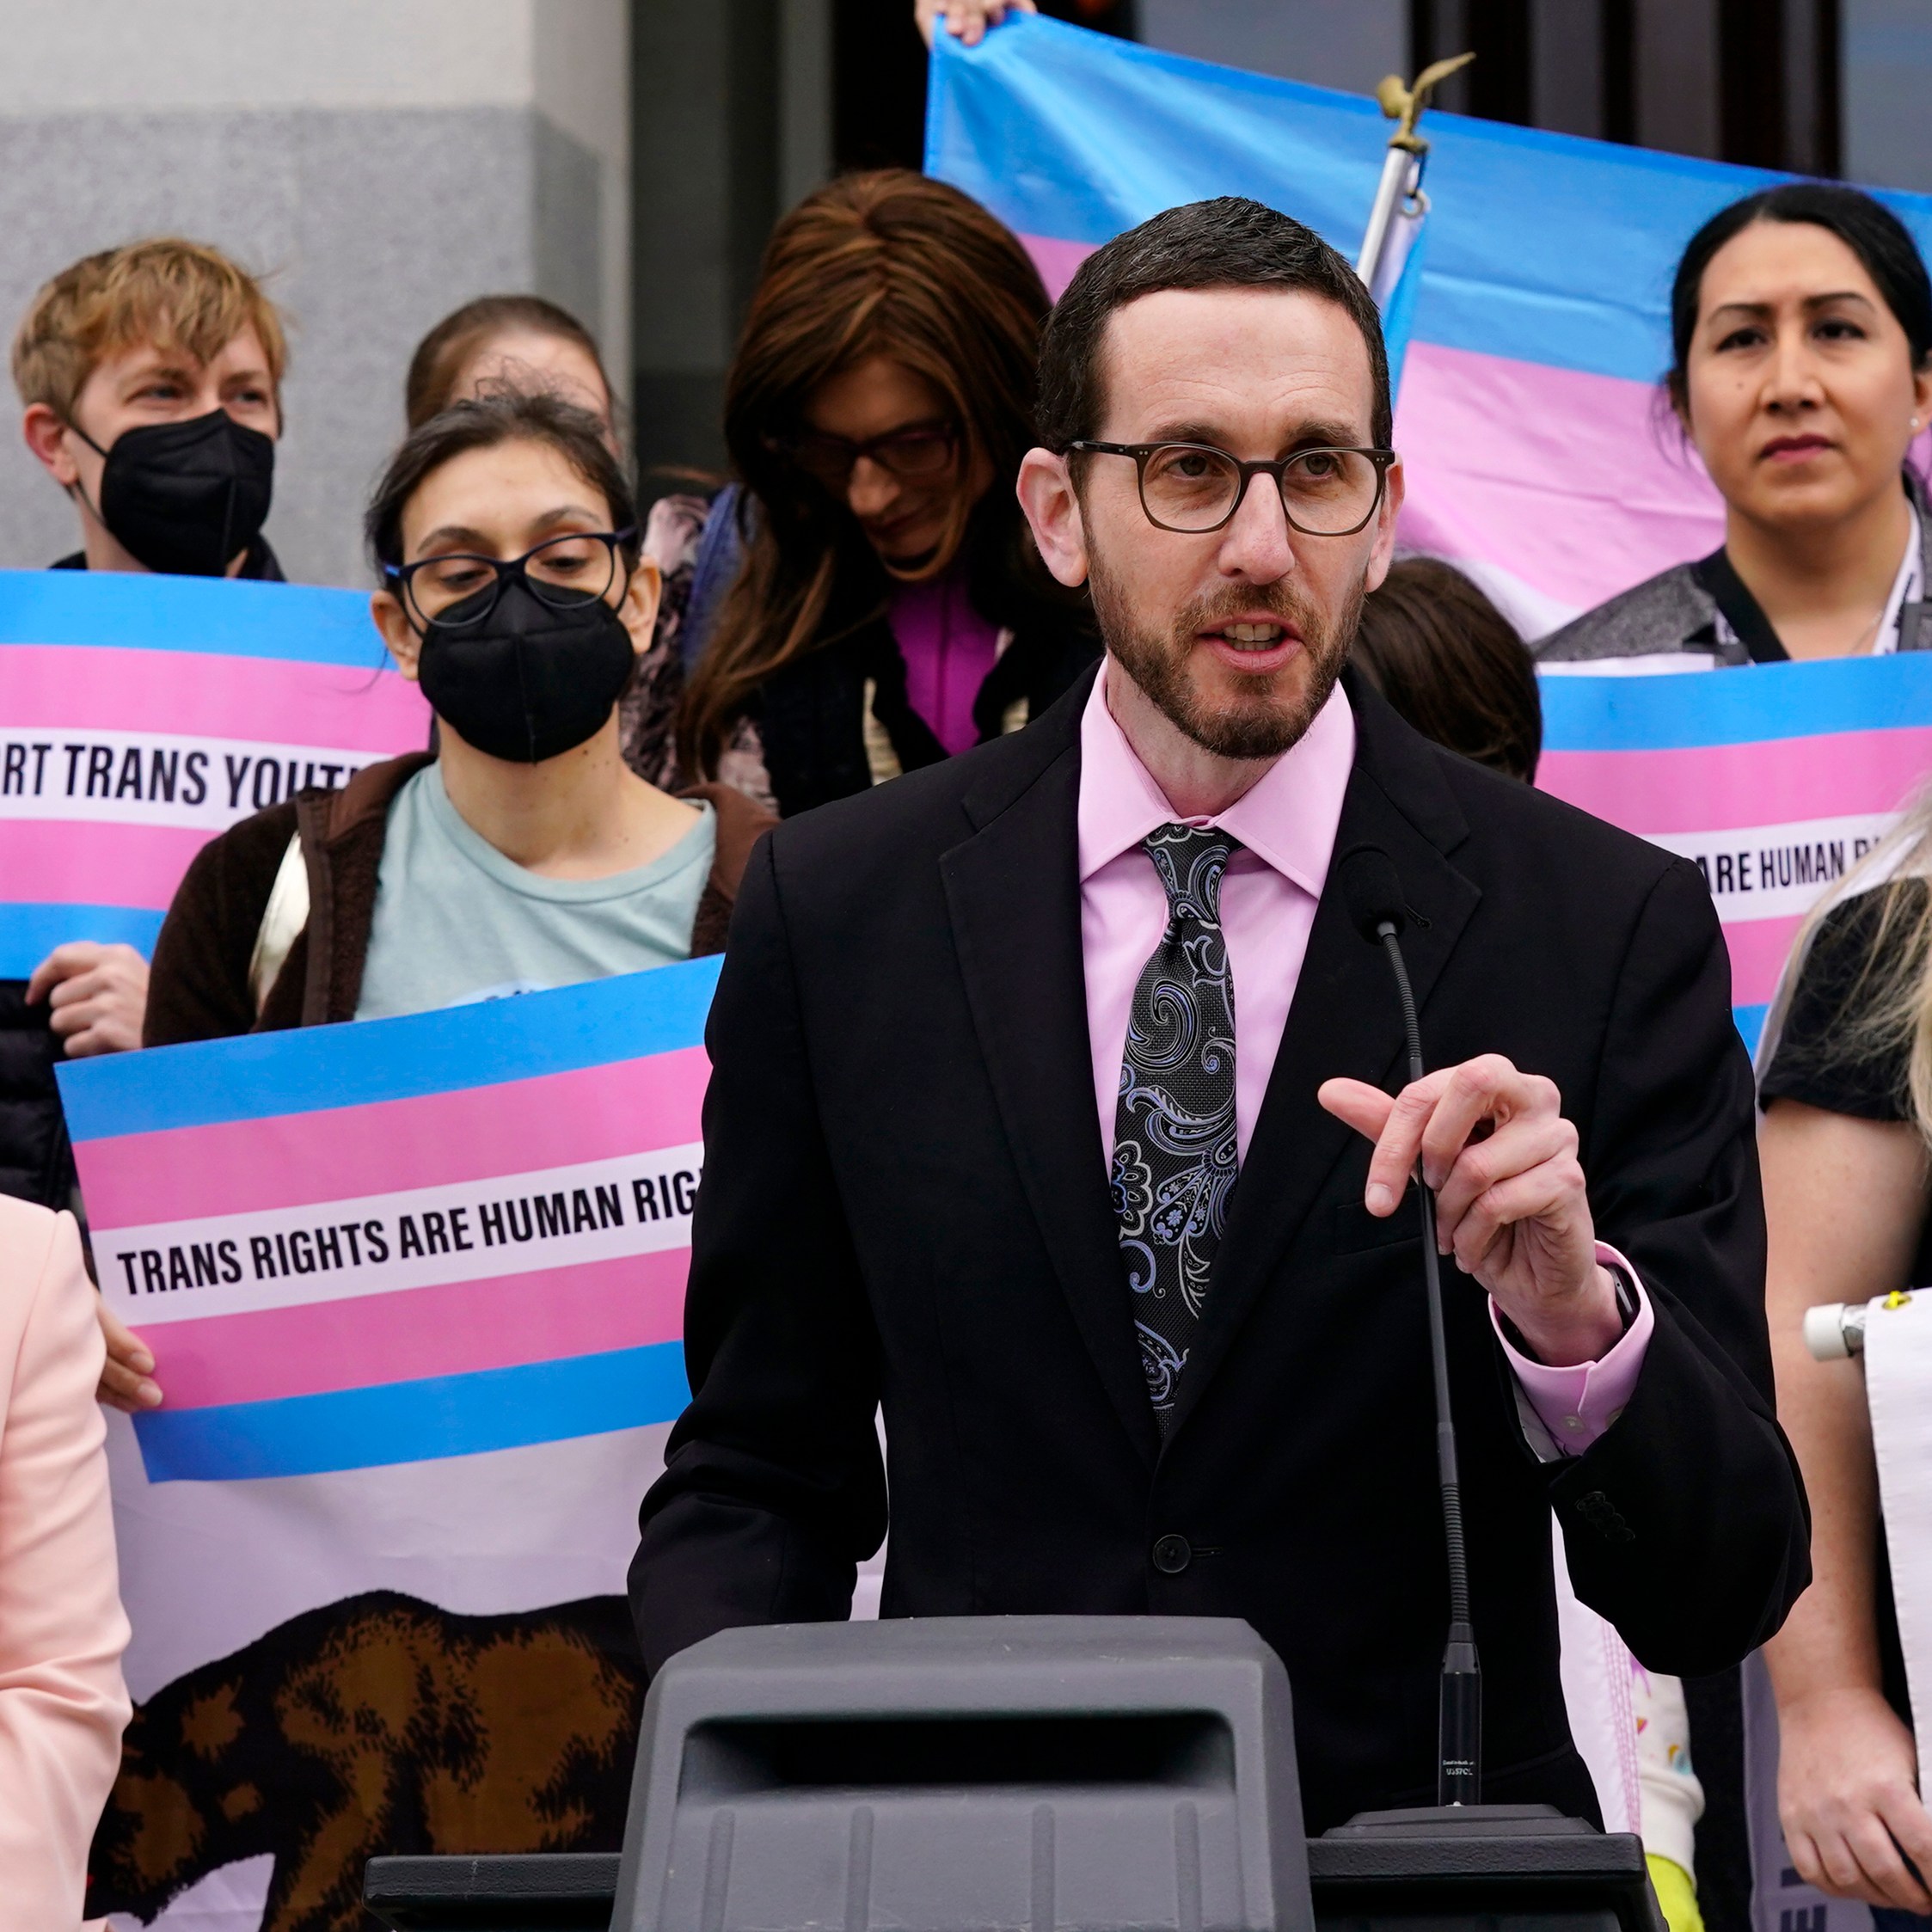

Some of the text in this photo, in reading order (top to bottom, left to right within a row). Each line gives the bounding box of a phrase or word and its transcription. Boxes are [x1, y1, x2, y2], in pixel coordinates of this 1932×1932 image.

[3, 743, 358, 810] RT TRANS YOUT
[1760, 841, 1844, 889] HUMAN
[116, 1168, 702, 1296] TRANS RIGHTS ARE HUMAN RIG
